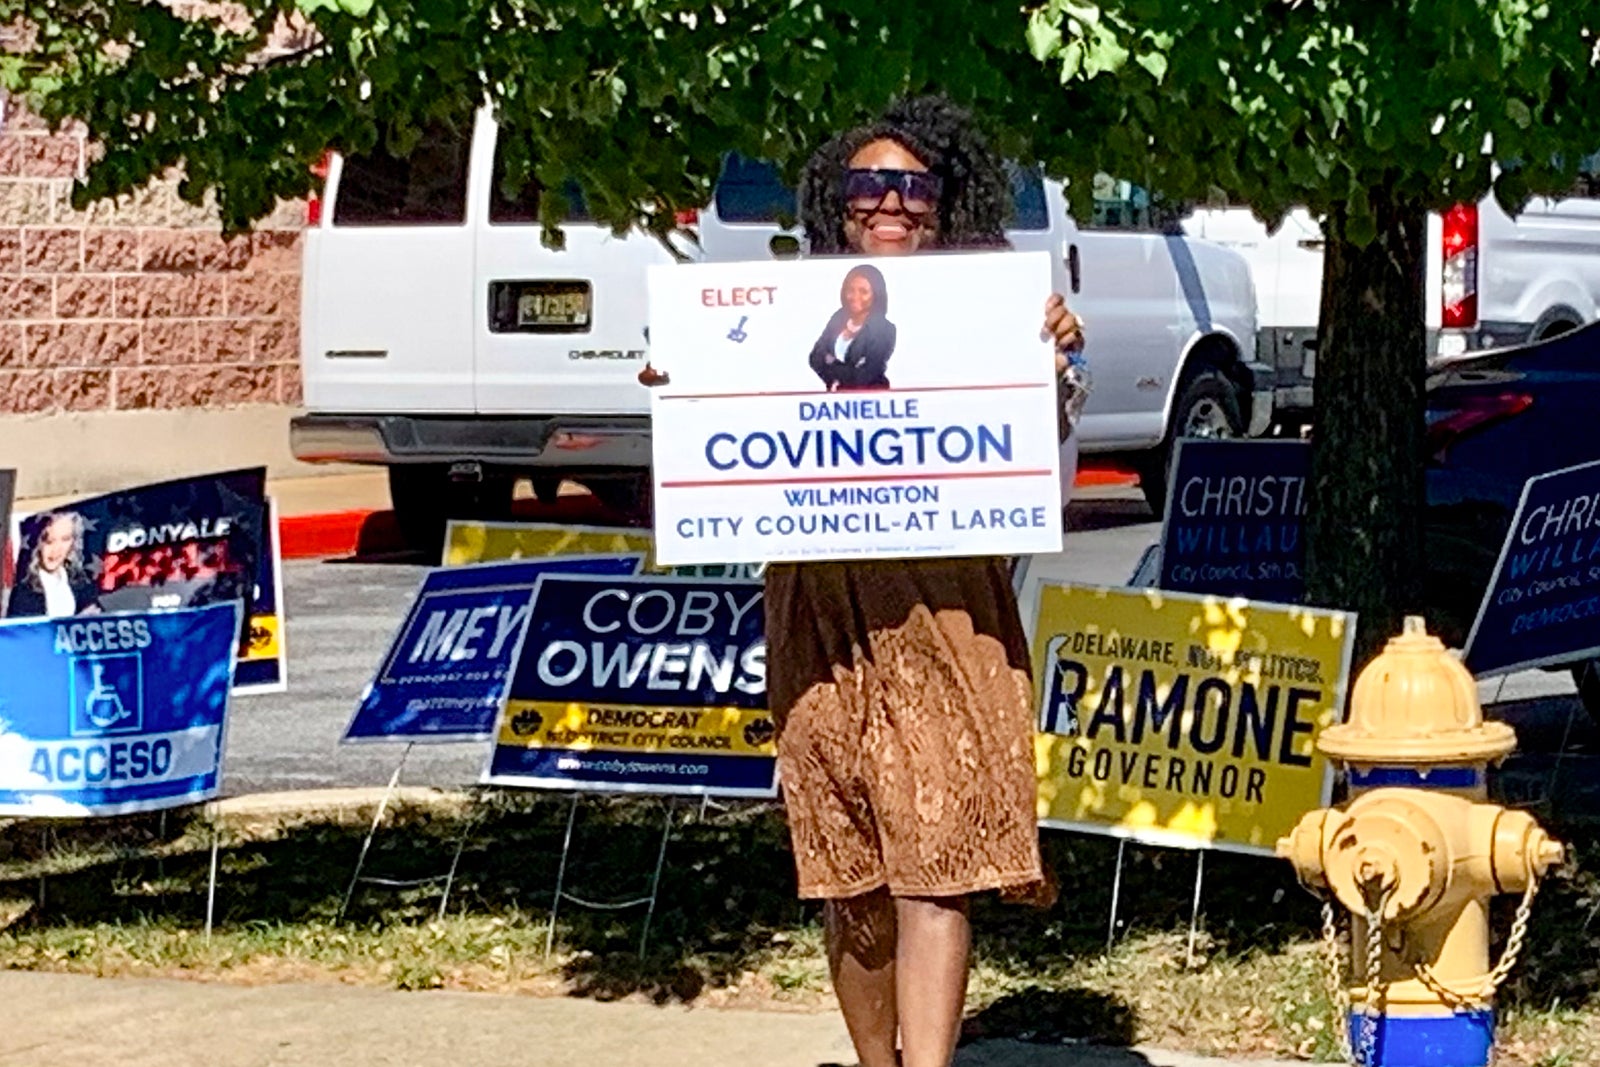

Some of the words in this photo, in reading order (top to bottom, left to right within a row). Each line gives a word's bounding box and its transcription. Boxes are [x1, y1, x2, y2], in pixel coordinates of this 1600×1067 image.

[702, 286, 778, 307] ELECT
[799, 398, 919, 421] DANIELLE
[705, 424, 1013, 471] COVINGTON
[784, 485, 939, 508] WILMINGTON
[106, 517, 233, 554] DONYALE
[676, 517, 744, 539] CITY
[755, 511, 939, 537] COUNCIL-AT
[951, 507, 1047, 531] LARGE
[1521, 492, 1600, 546] CHRI
[583, 589, 765, 635] COBY
[55, 619, 152, 655] ACCESS
[1072, 631, 1180, 667] DELAWARE,
[537, 639, 768, 695] OWENS
[587, 709, 703, 729] DEMOCRAT
[1044, 659, 1322, 768] RAMONE
[29, 738, 173, 784] ACCESO
[1067, 745, 1266, 804] GOVERNOR
